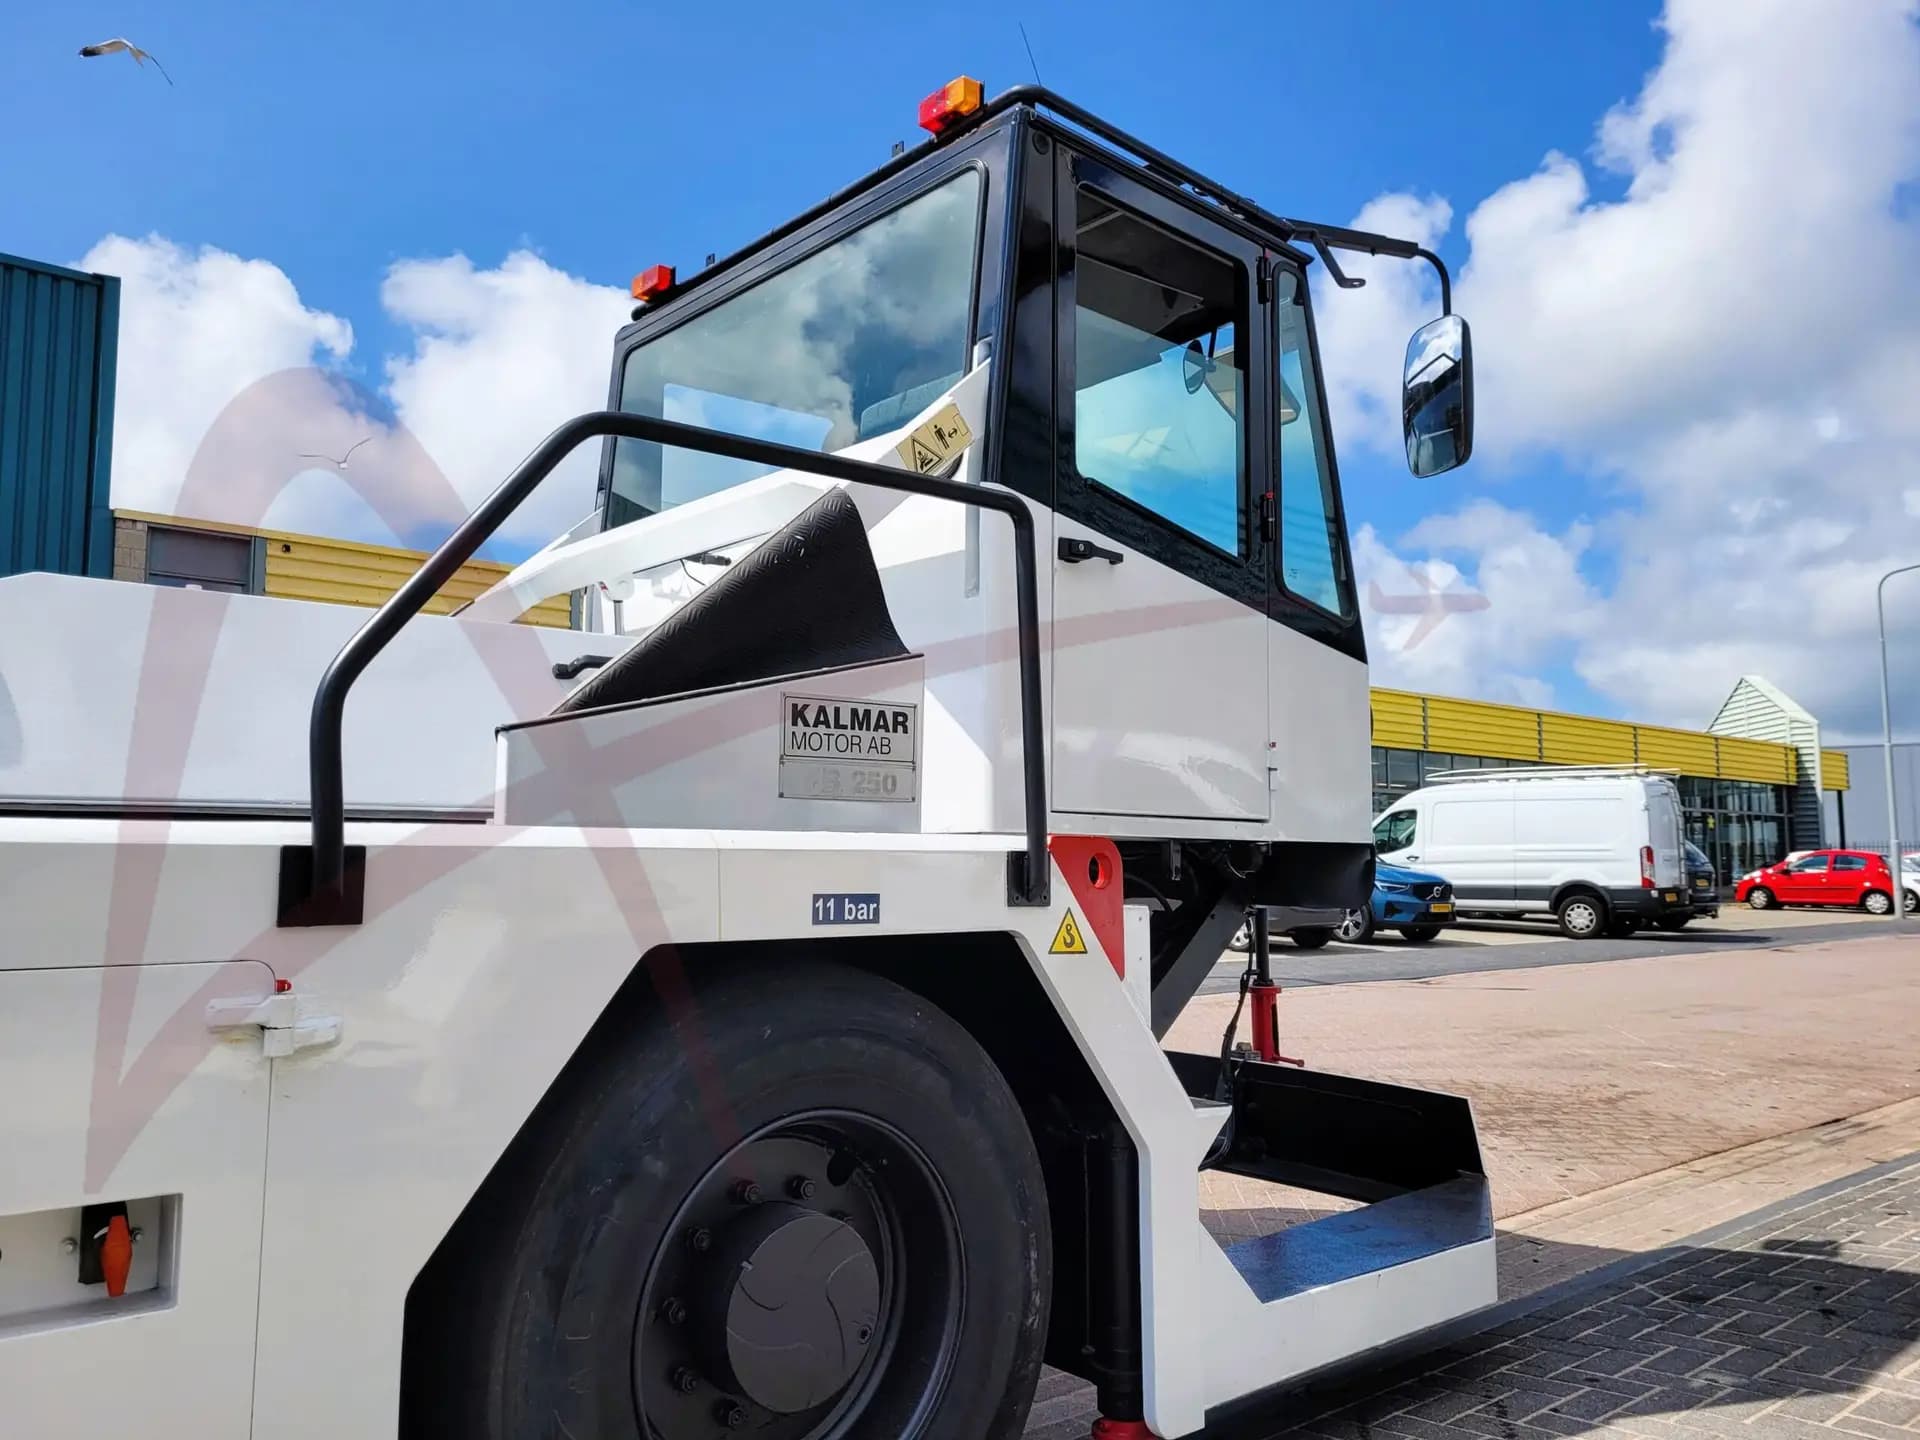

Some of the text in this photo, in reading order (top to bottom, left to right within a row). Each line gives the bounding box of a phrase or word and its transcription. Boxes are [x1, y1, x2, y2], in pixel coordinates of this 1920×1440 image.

[791, 703, 909, 734] KALMAR
[791, 731, 892, 755] MOTOR AB
[851, 770, 898, 795] 250
[815, 898, 877, 921] 11 bar
